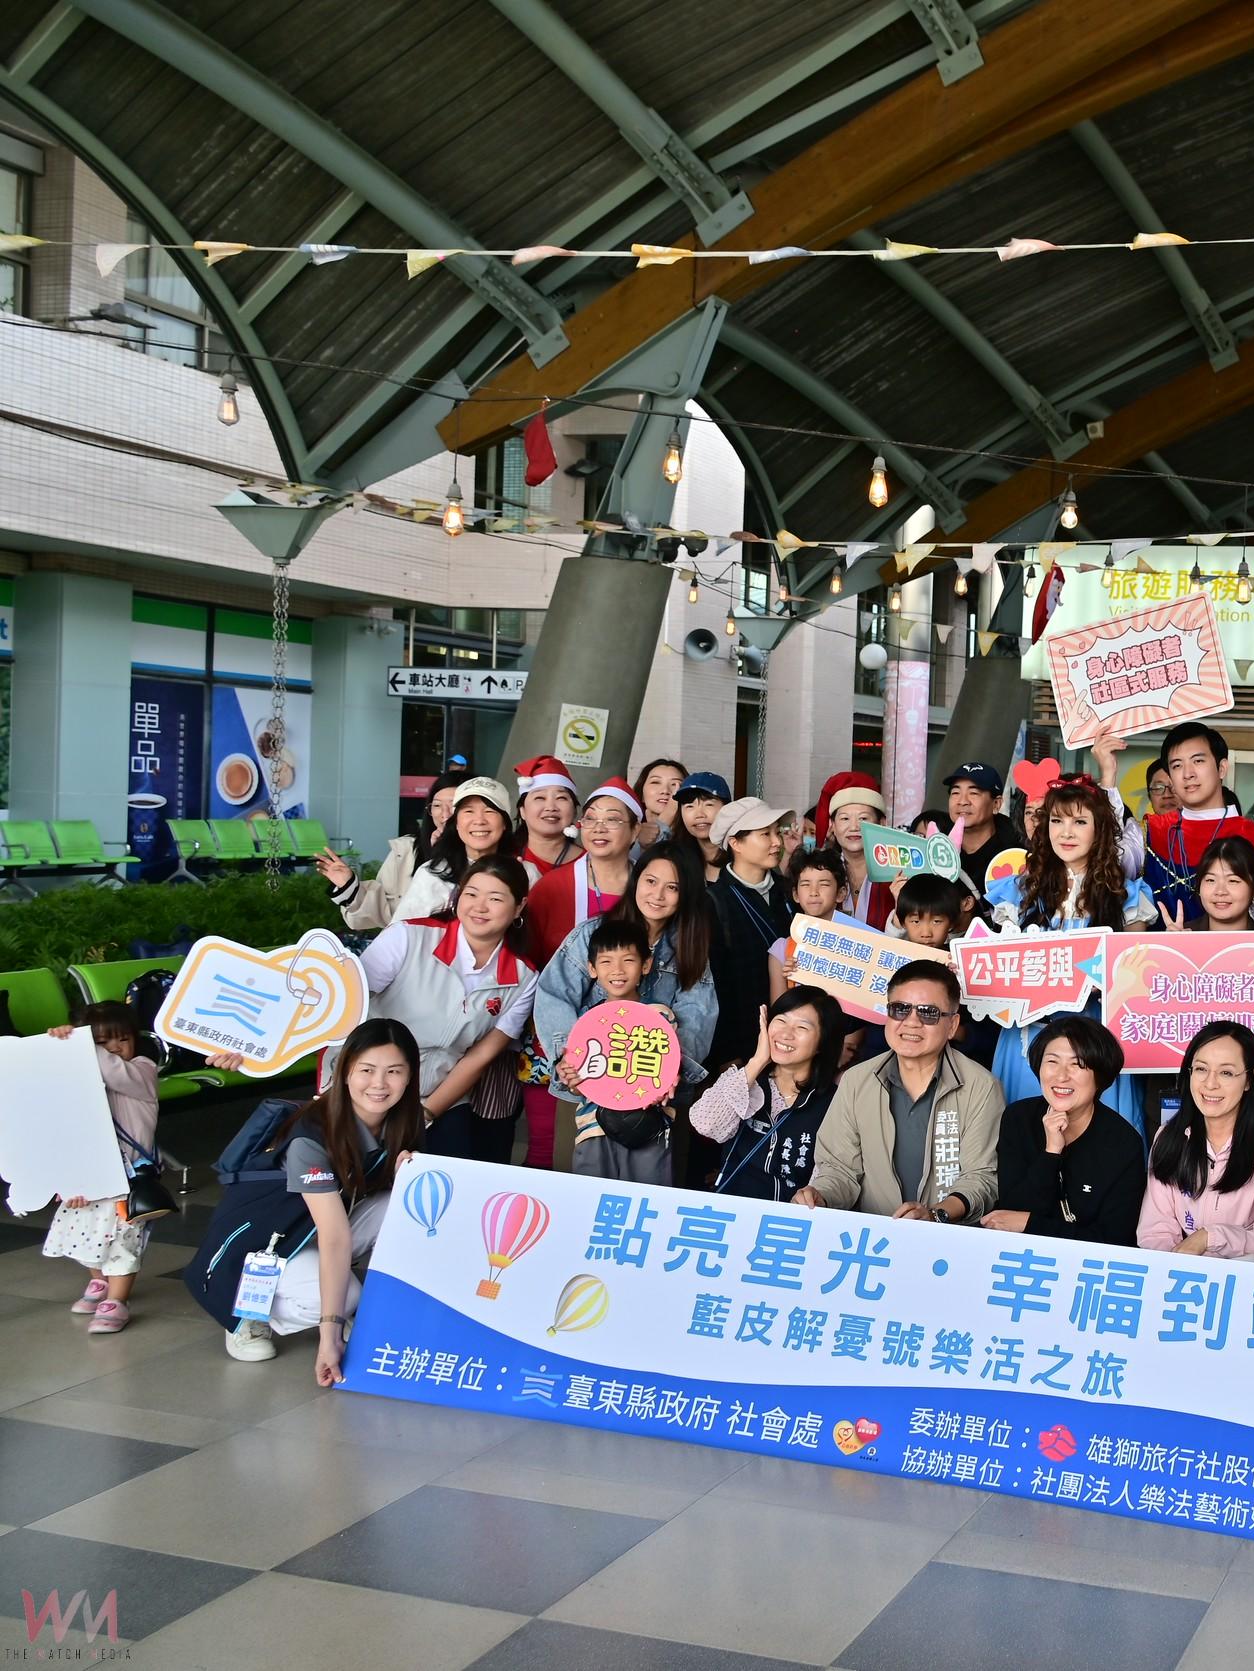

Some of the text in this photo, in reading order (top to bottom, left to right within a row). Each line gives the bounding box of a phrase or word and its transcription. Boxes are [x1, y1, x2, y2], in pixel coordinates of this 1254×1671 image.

[1086, 635, 1183, 680] 身心障礙者
[408, 673, 460, 688] 車站大廳
[1090, 661, 1188, 705] 社區式服務
[131, 702, 161, 773] 單品
[873, 843, 925, 869] CRPD
[802, 927, 873, 962] 用愛無礙
[797, 951, 865, 987] 關懷與愛
[968, 946, 1074, 986] 公平參與
[173, 1017, 268, 1058] 臺東縣政府社會處
[607, 1023, 670, 1089] 讚
[687, 1293, 1128, 1399] 藍皮解憂號樂活之旅
[562, 1373, 720, 1432] 臺東縣政府
[725, 1400, 824, 1449] 社會處
